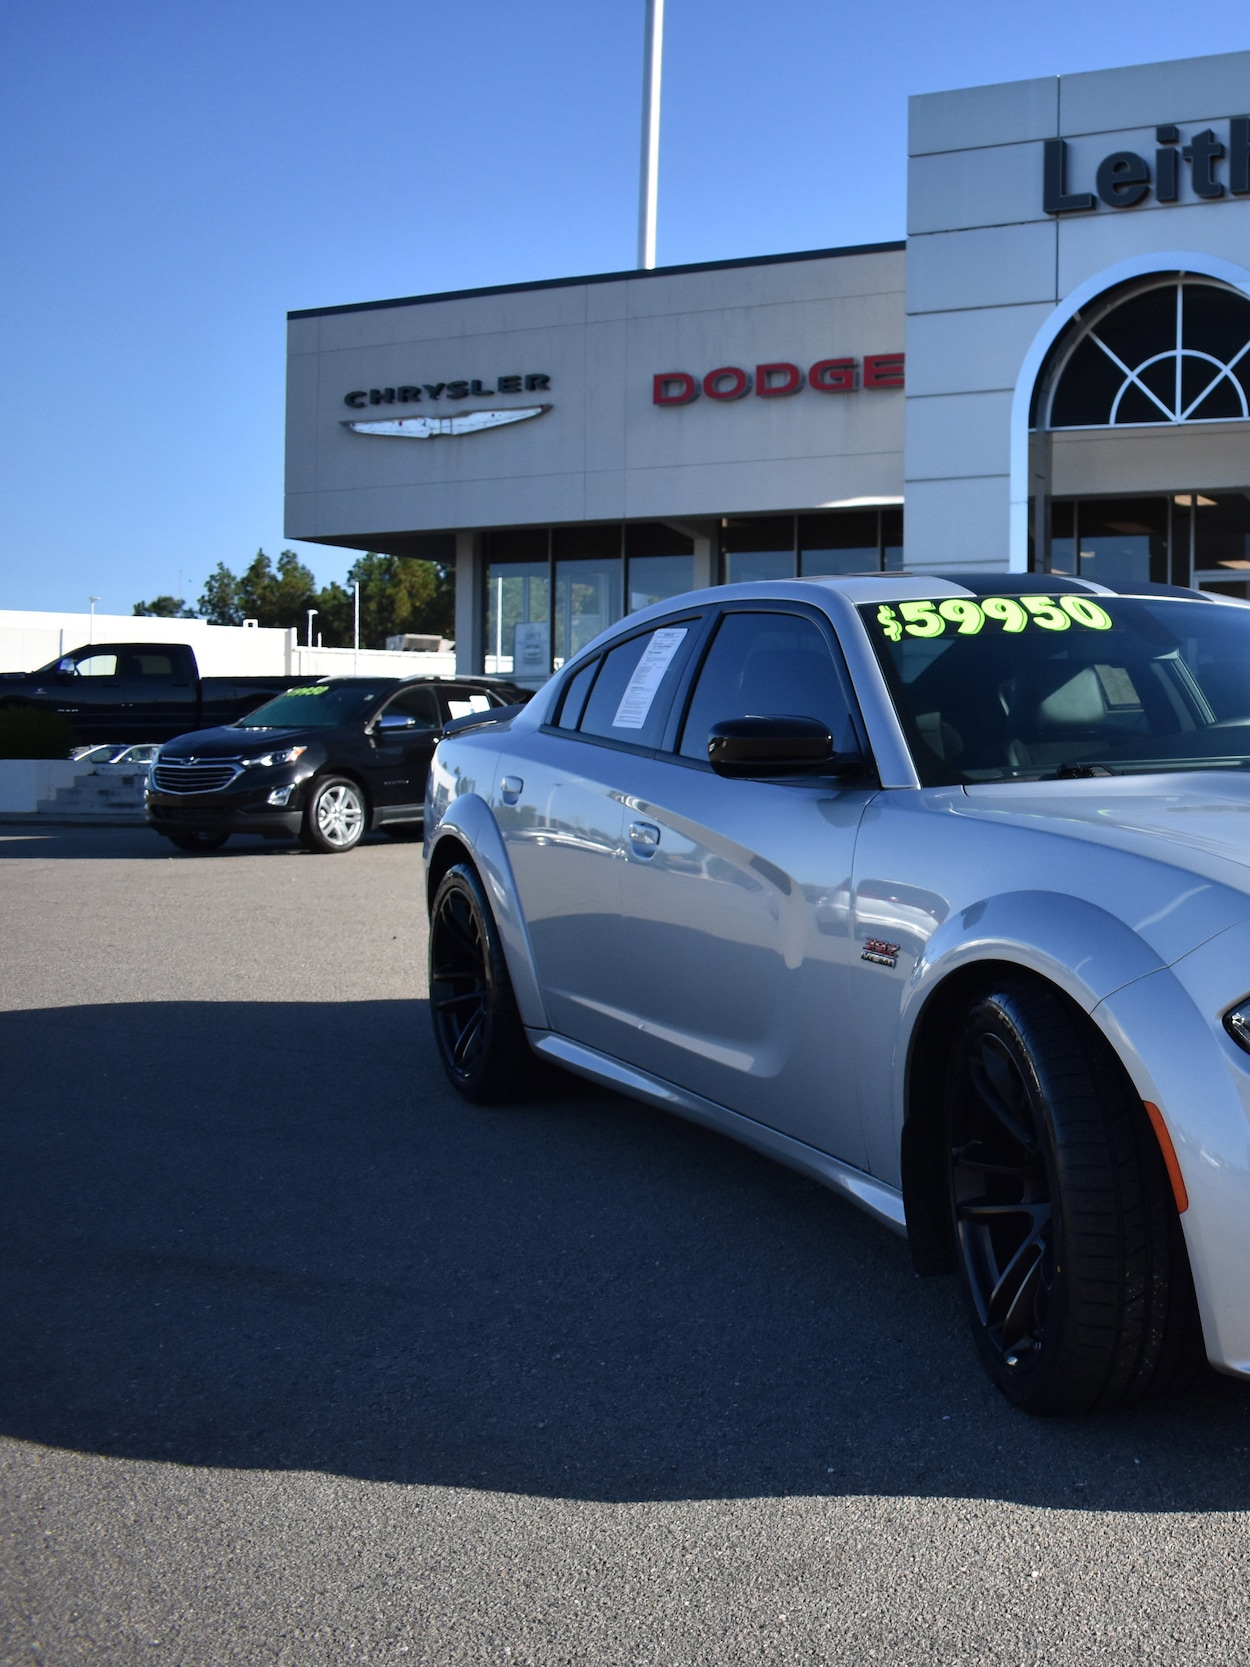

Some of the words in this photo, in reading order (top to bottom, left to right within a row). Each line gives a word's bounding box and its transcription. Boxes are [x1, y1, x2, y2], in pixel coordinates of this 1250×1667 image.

[344, 373, 551, 408] CHRYSLER
[653, 352, 905, 405] DODGE
[876, 595, 1113, 642] $59950
[863, 936, 901, 959] 392
